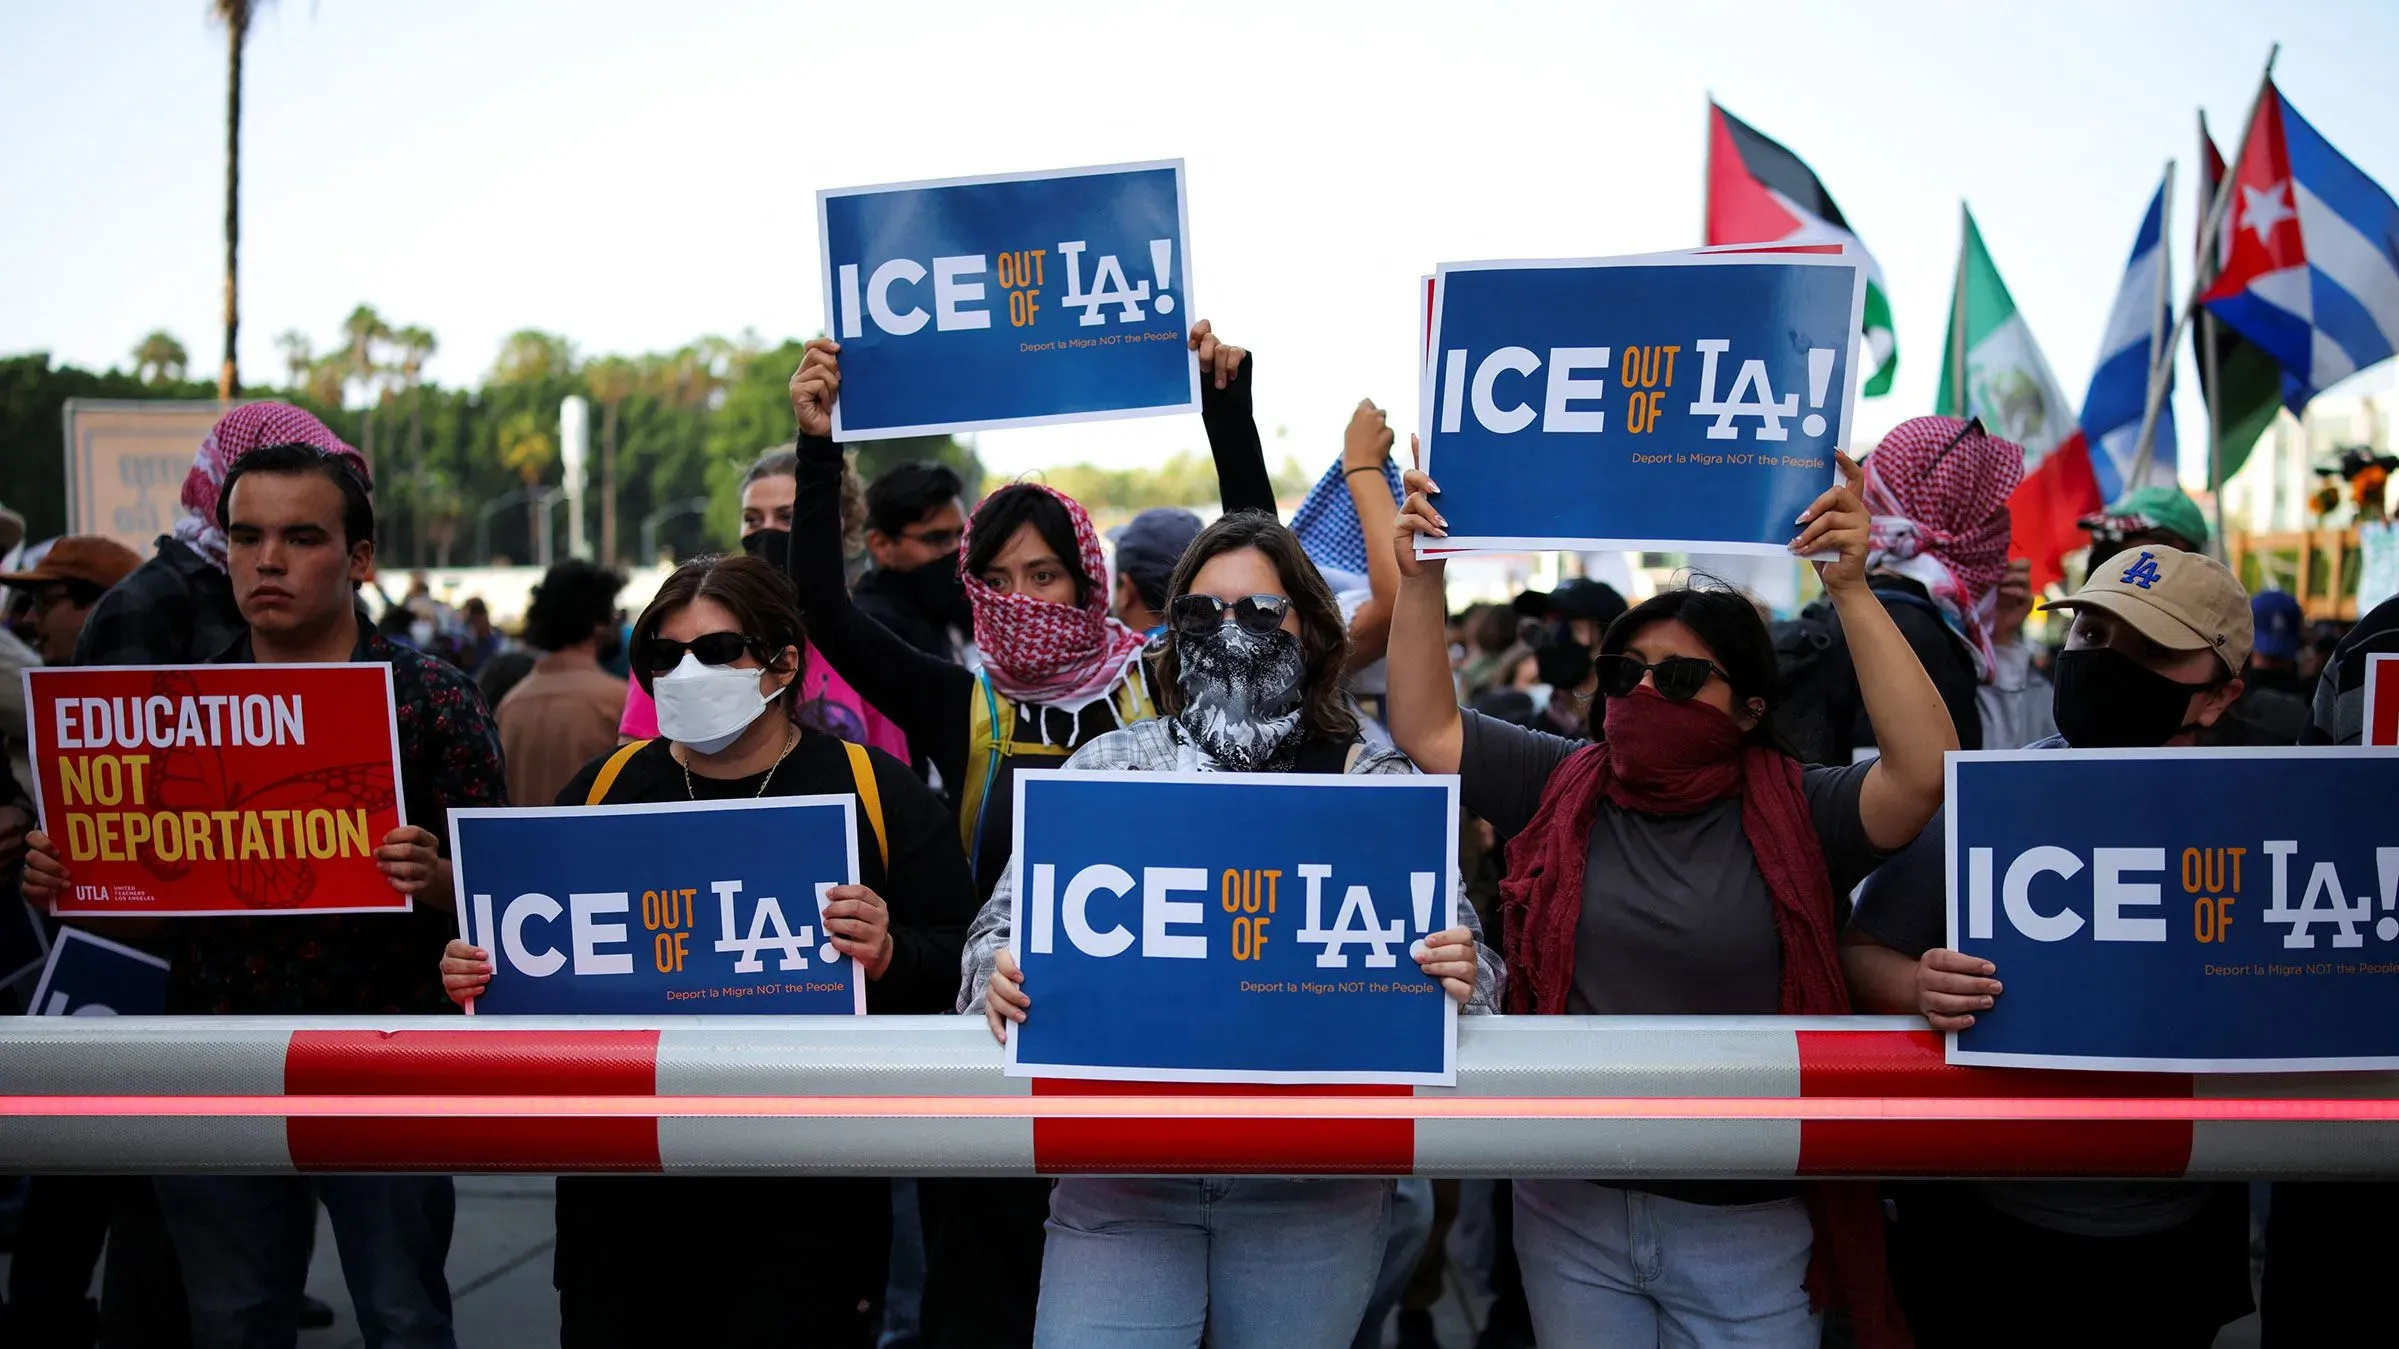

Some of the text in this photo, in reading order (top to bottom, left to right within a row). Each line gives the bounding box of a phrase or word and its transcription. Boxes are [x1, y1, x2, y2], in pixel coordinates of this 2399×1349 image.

[997, 249, 1046, 288] OUT
[839, 254, 992, 338] ICE
[1008, 289, 1040, 327] OF
[1020, 331, 1178, 351] Deport la Migra NOT the People
[1621, 345, 1681, 388] OUT
[1440, 346, 1611, 434] ICE
[1626, 391, 1666, 434] OF
[1632, 452, 1825, 469] Deport la Migra NOT the People
[2120, 551, 2161, 589] LA
[55, 694, 305, 748] EDUCATION
[58, 754, 150, 806] NOT
[66, 808, 371, 862] DEPORTATION
[1220, 868, 1282, 913] OUT
[2181, 847, 2247, 893] OUT
[76, 885, 109, 901] UTLA
[642, 888, 697, 931] OUT
[1030, 863, 1208, 958] ICE
[1969, 845, 2167, 942] ICE
[473, 892, 634, 977] ICE
[1232, 916, 1270, 961] OF
[2194, 897, 2235, 943] OF
[654, 932, 690, 973] OF
[2205, 963, 2399, 976] Deport la Migra NOT the People
[667, 982, 844, 1000] Deport la Migra NOT the People
[1240, 981, 1434, 993] Deport la Migra NOT the People
